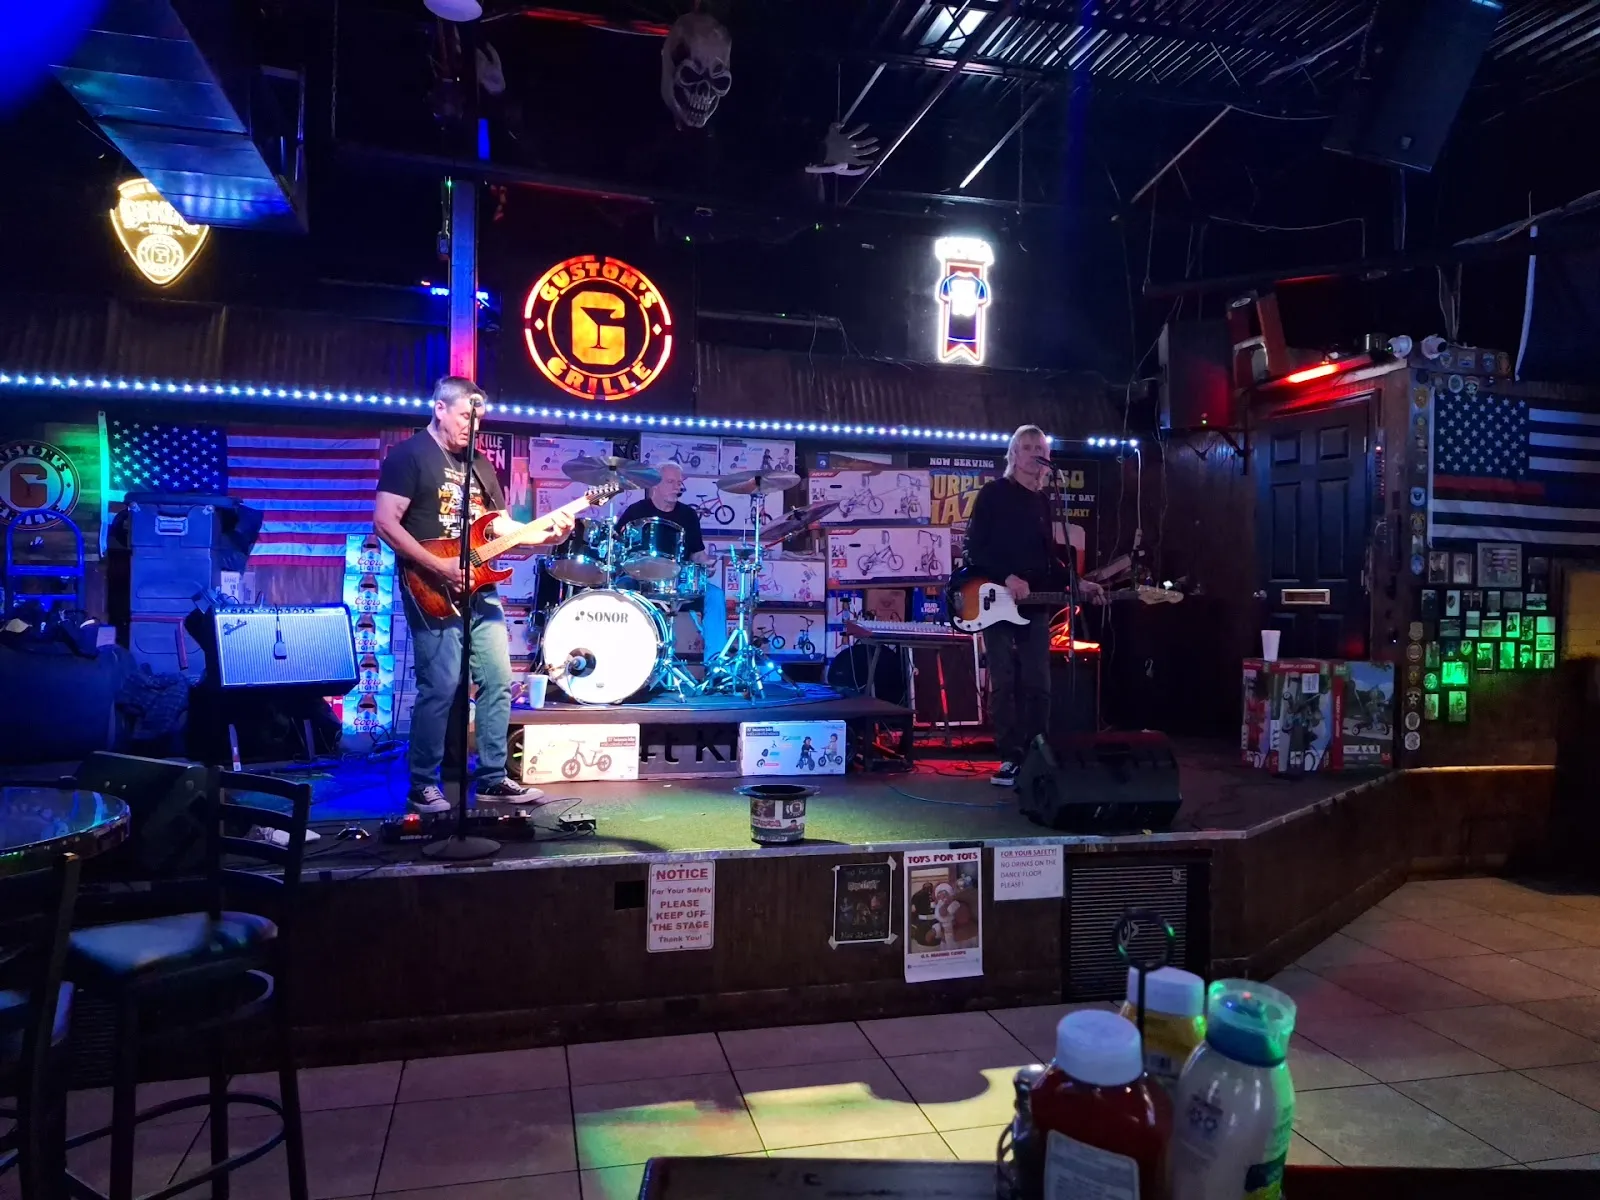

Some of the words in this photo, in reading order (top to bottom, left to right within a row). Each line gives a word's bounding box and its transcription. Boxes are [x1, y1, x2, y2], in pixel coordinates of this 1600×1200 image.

[539, 262, 659, 309] GUSTON'S
[547, 356, 653, 395] GRILLE
[929, 457, 949, 466] NOW
[954, 458, 995, 470] SERVING
[930, 474, 995, 500] URPL
[1050, 493, 1076, 501] EERY
[586, 611, 629, 623] SONOR
[908, 855, 931, 864] TOYS
[933, 853, 954, 863] FOR
[957, 851, 978, 861] TOTS
[1014, 849, 1032, 858] YOUR
[1033, 848, 1057, 857] SAFETY!
[1011, 860, 1034, 868] DRINKS
[656, 868, 709, 881] NOTICE
[687, 886, 712, 894] Safety
[660, 900, 700, 909] PLEASE
[656, 911, 684, 920] KEEP
[686, 910, 707, 919] OFF
[652, 923, 673, 932] THE
[675, 920, 710, 930] STAGE
[685, 934, 702, 942] You!
